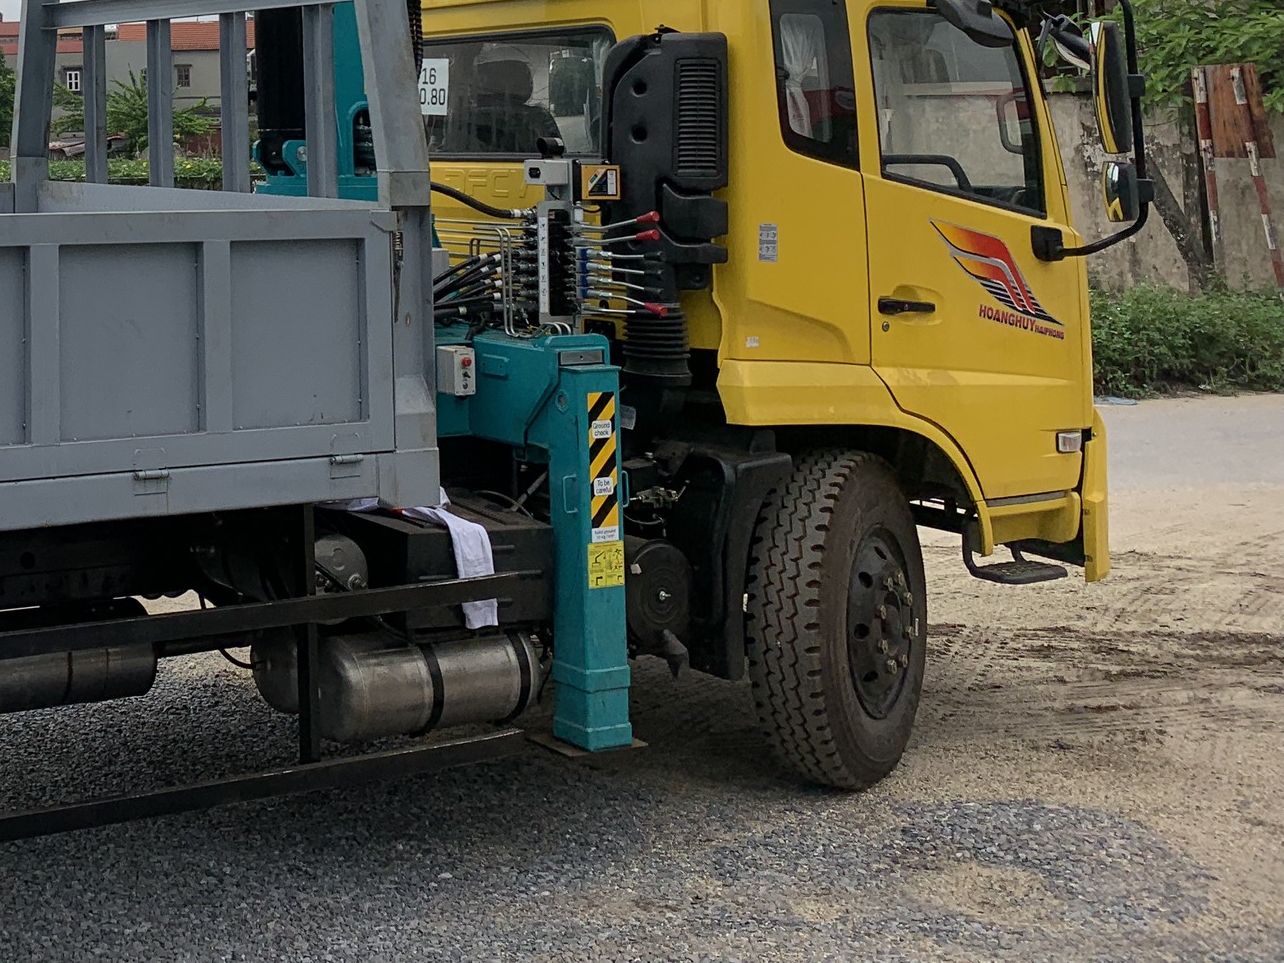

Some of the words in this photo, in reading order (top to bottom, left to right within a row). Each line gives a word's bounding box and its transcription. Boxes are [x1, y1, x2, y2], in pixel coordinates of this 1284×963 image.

[422, 67, 437, 85] 16
[979, 304, 1036, 332] HOANGHUY
[592, 422, 611, 430] Ground
[594, 429, 609, 437] check
